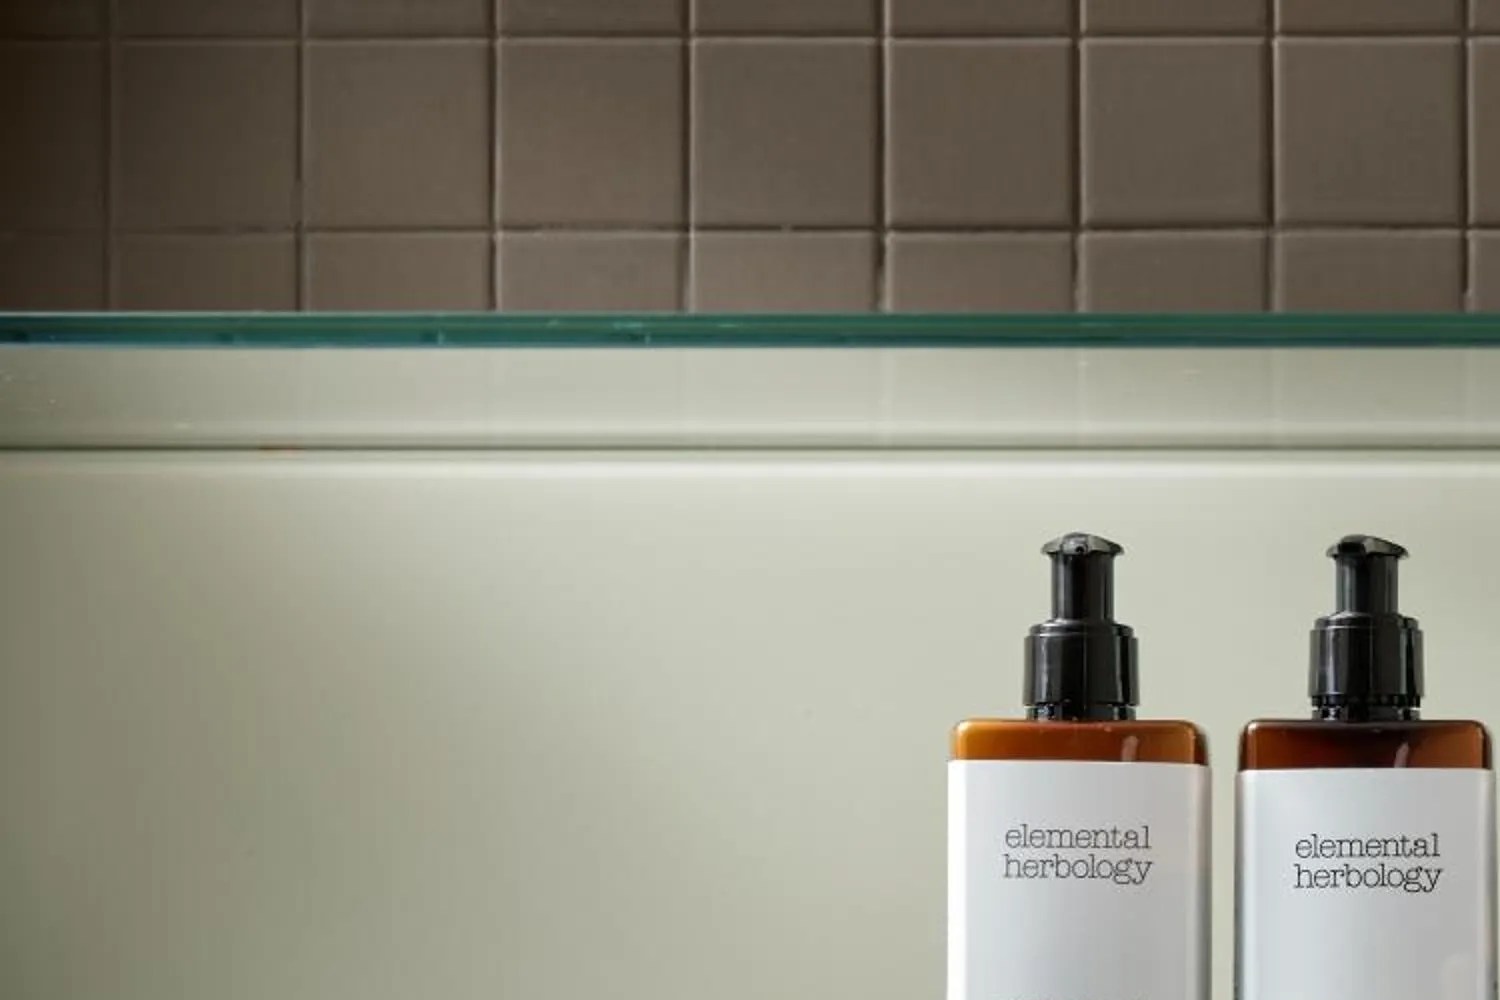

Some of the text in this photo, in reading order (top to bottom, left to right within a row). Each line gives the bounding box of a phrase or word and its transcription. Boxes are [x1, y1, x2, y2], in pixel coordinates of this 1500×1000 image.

[1004, 823, 1152, 849] elemental
[1295, 833, 1441, 858] elemental
[1002, 853, 1154, 885] herbology
[1293, 863, 1444, 893] herbology
